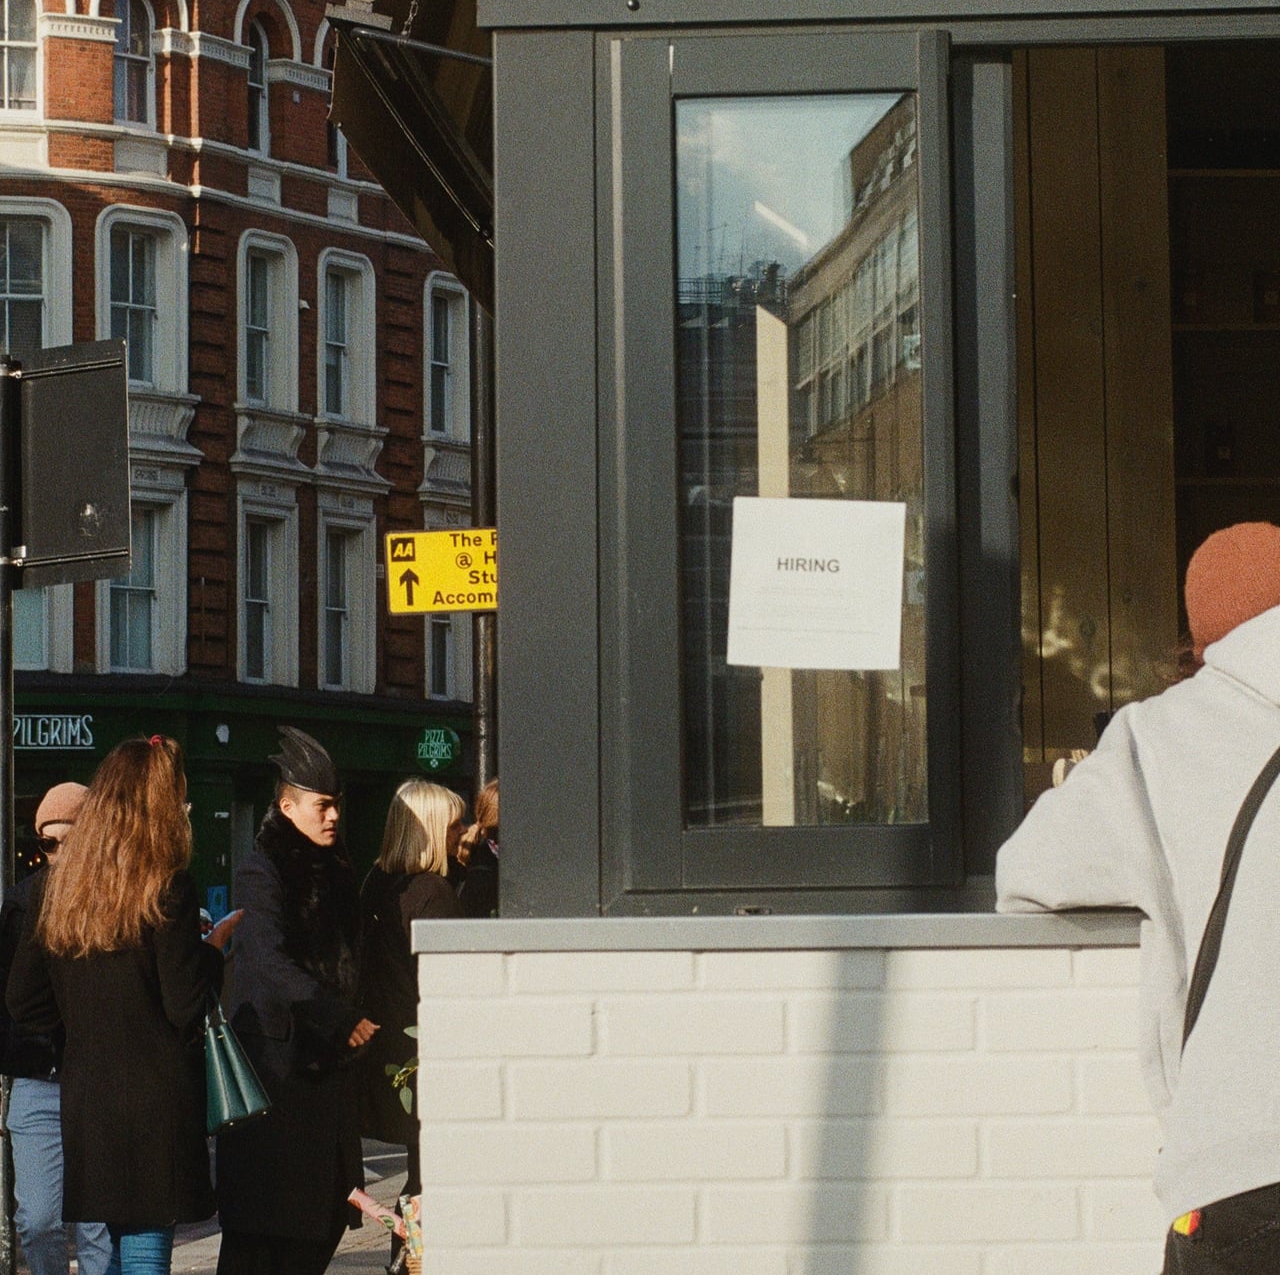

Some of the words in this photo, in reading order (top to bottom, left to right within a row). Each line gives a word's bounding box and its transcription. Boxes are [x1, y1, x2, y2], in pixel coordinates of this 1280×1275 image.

[449, 533, 483, 547] The
[393, 543, 413, 558] AA
[777, 557, 841, 573] HIRING
[432, 590, 498, 605] Accom
[425, 729, 445, 743] PIZZA
[418, 742, 452, 757] PILGRIMS
